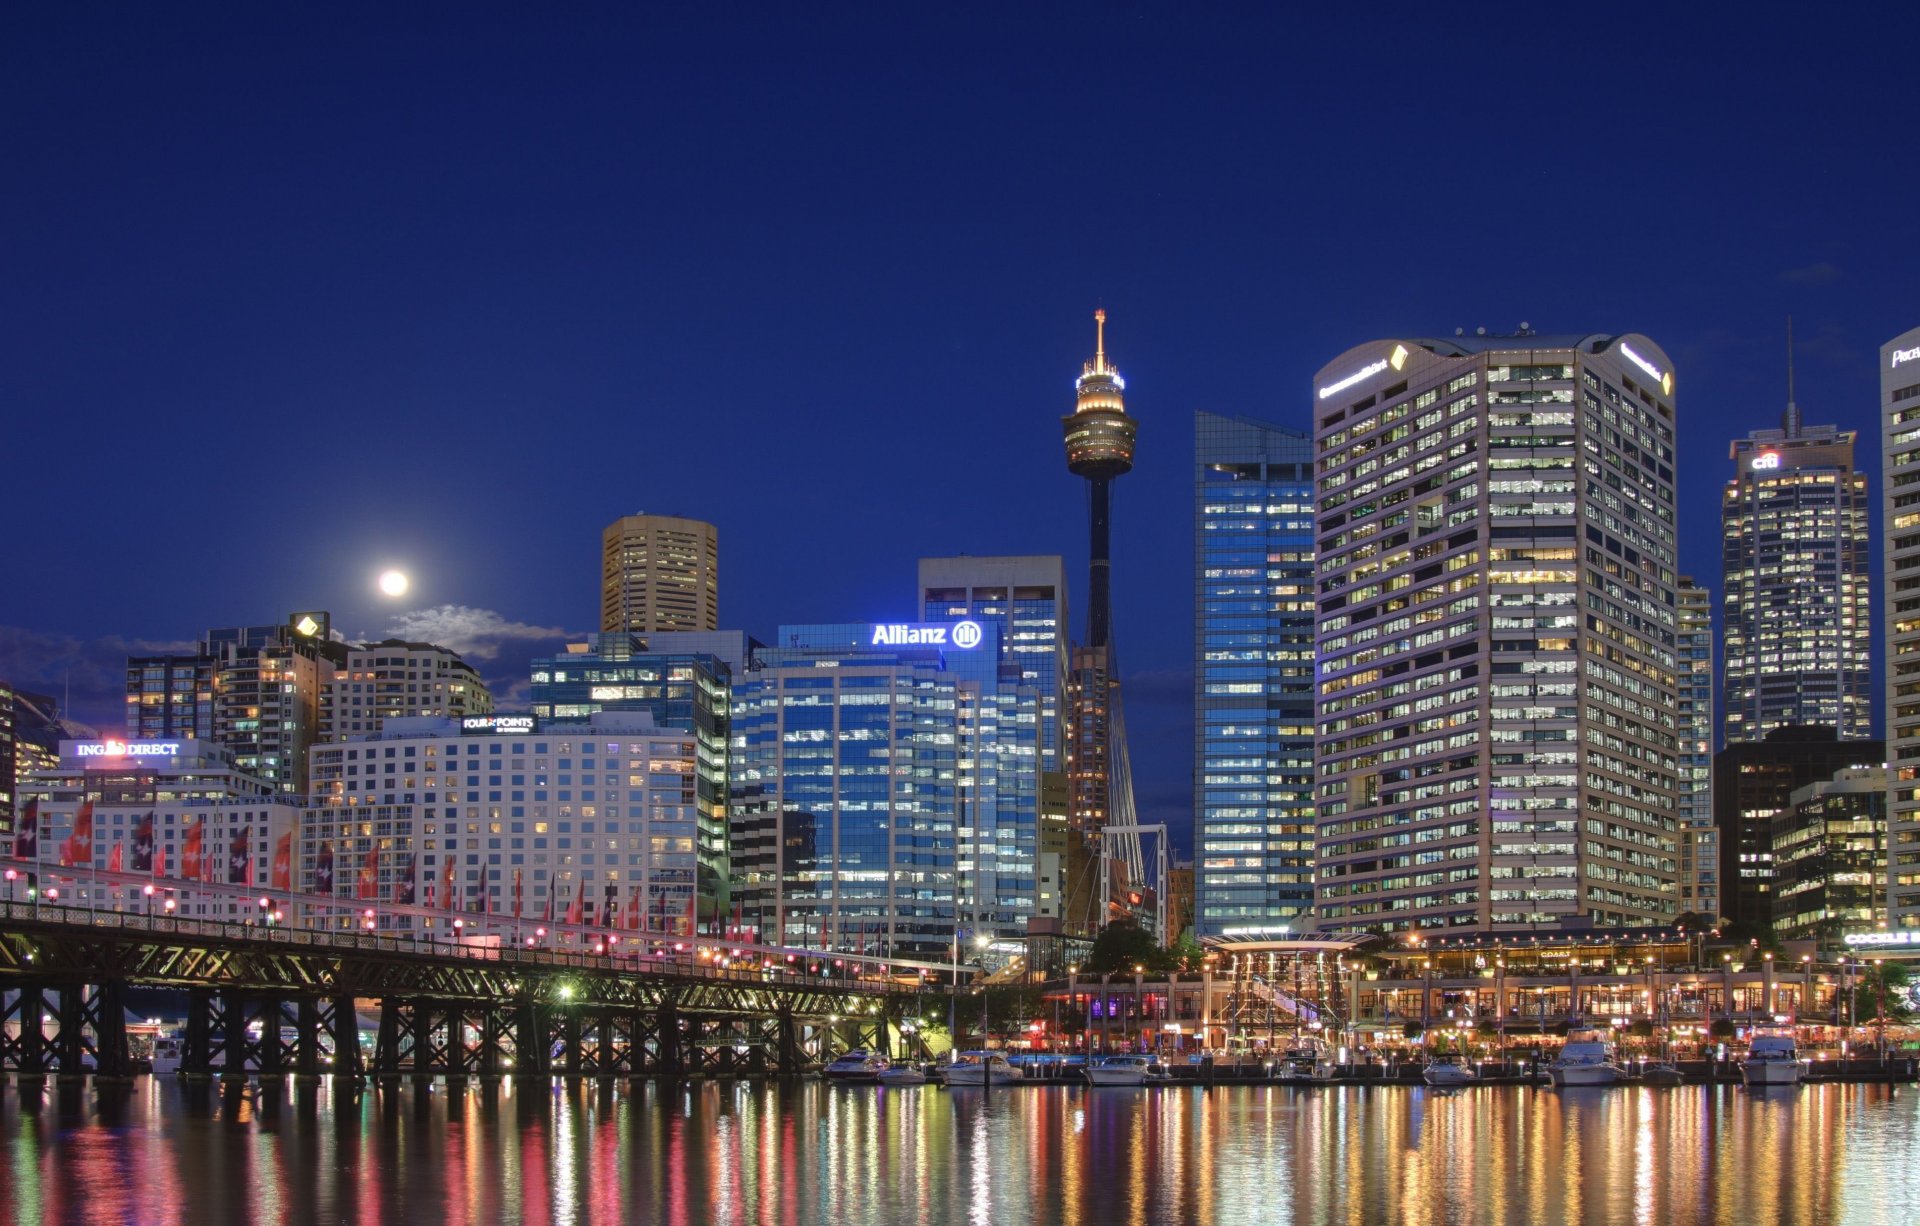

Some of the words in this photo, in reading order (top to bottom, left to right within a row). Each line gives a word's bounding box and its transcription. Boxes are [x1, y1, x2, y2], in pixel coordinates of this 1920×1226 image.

[1752, 454, 1778, 469] citi
[872, 625, 946, 644] Allianz
[464, 718, 488, 728] FOUR
[497, 718, 533, 727] POINTS
[78, 745, 104, 755] ING
[128, 744, 179, 755] DIRECT
